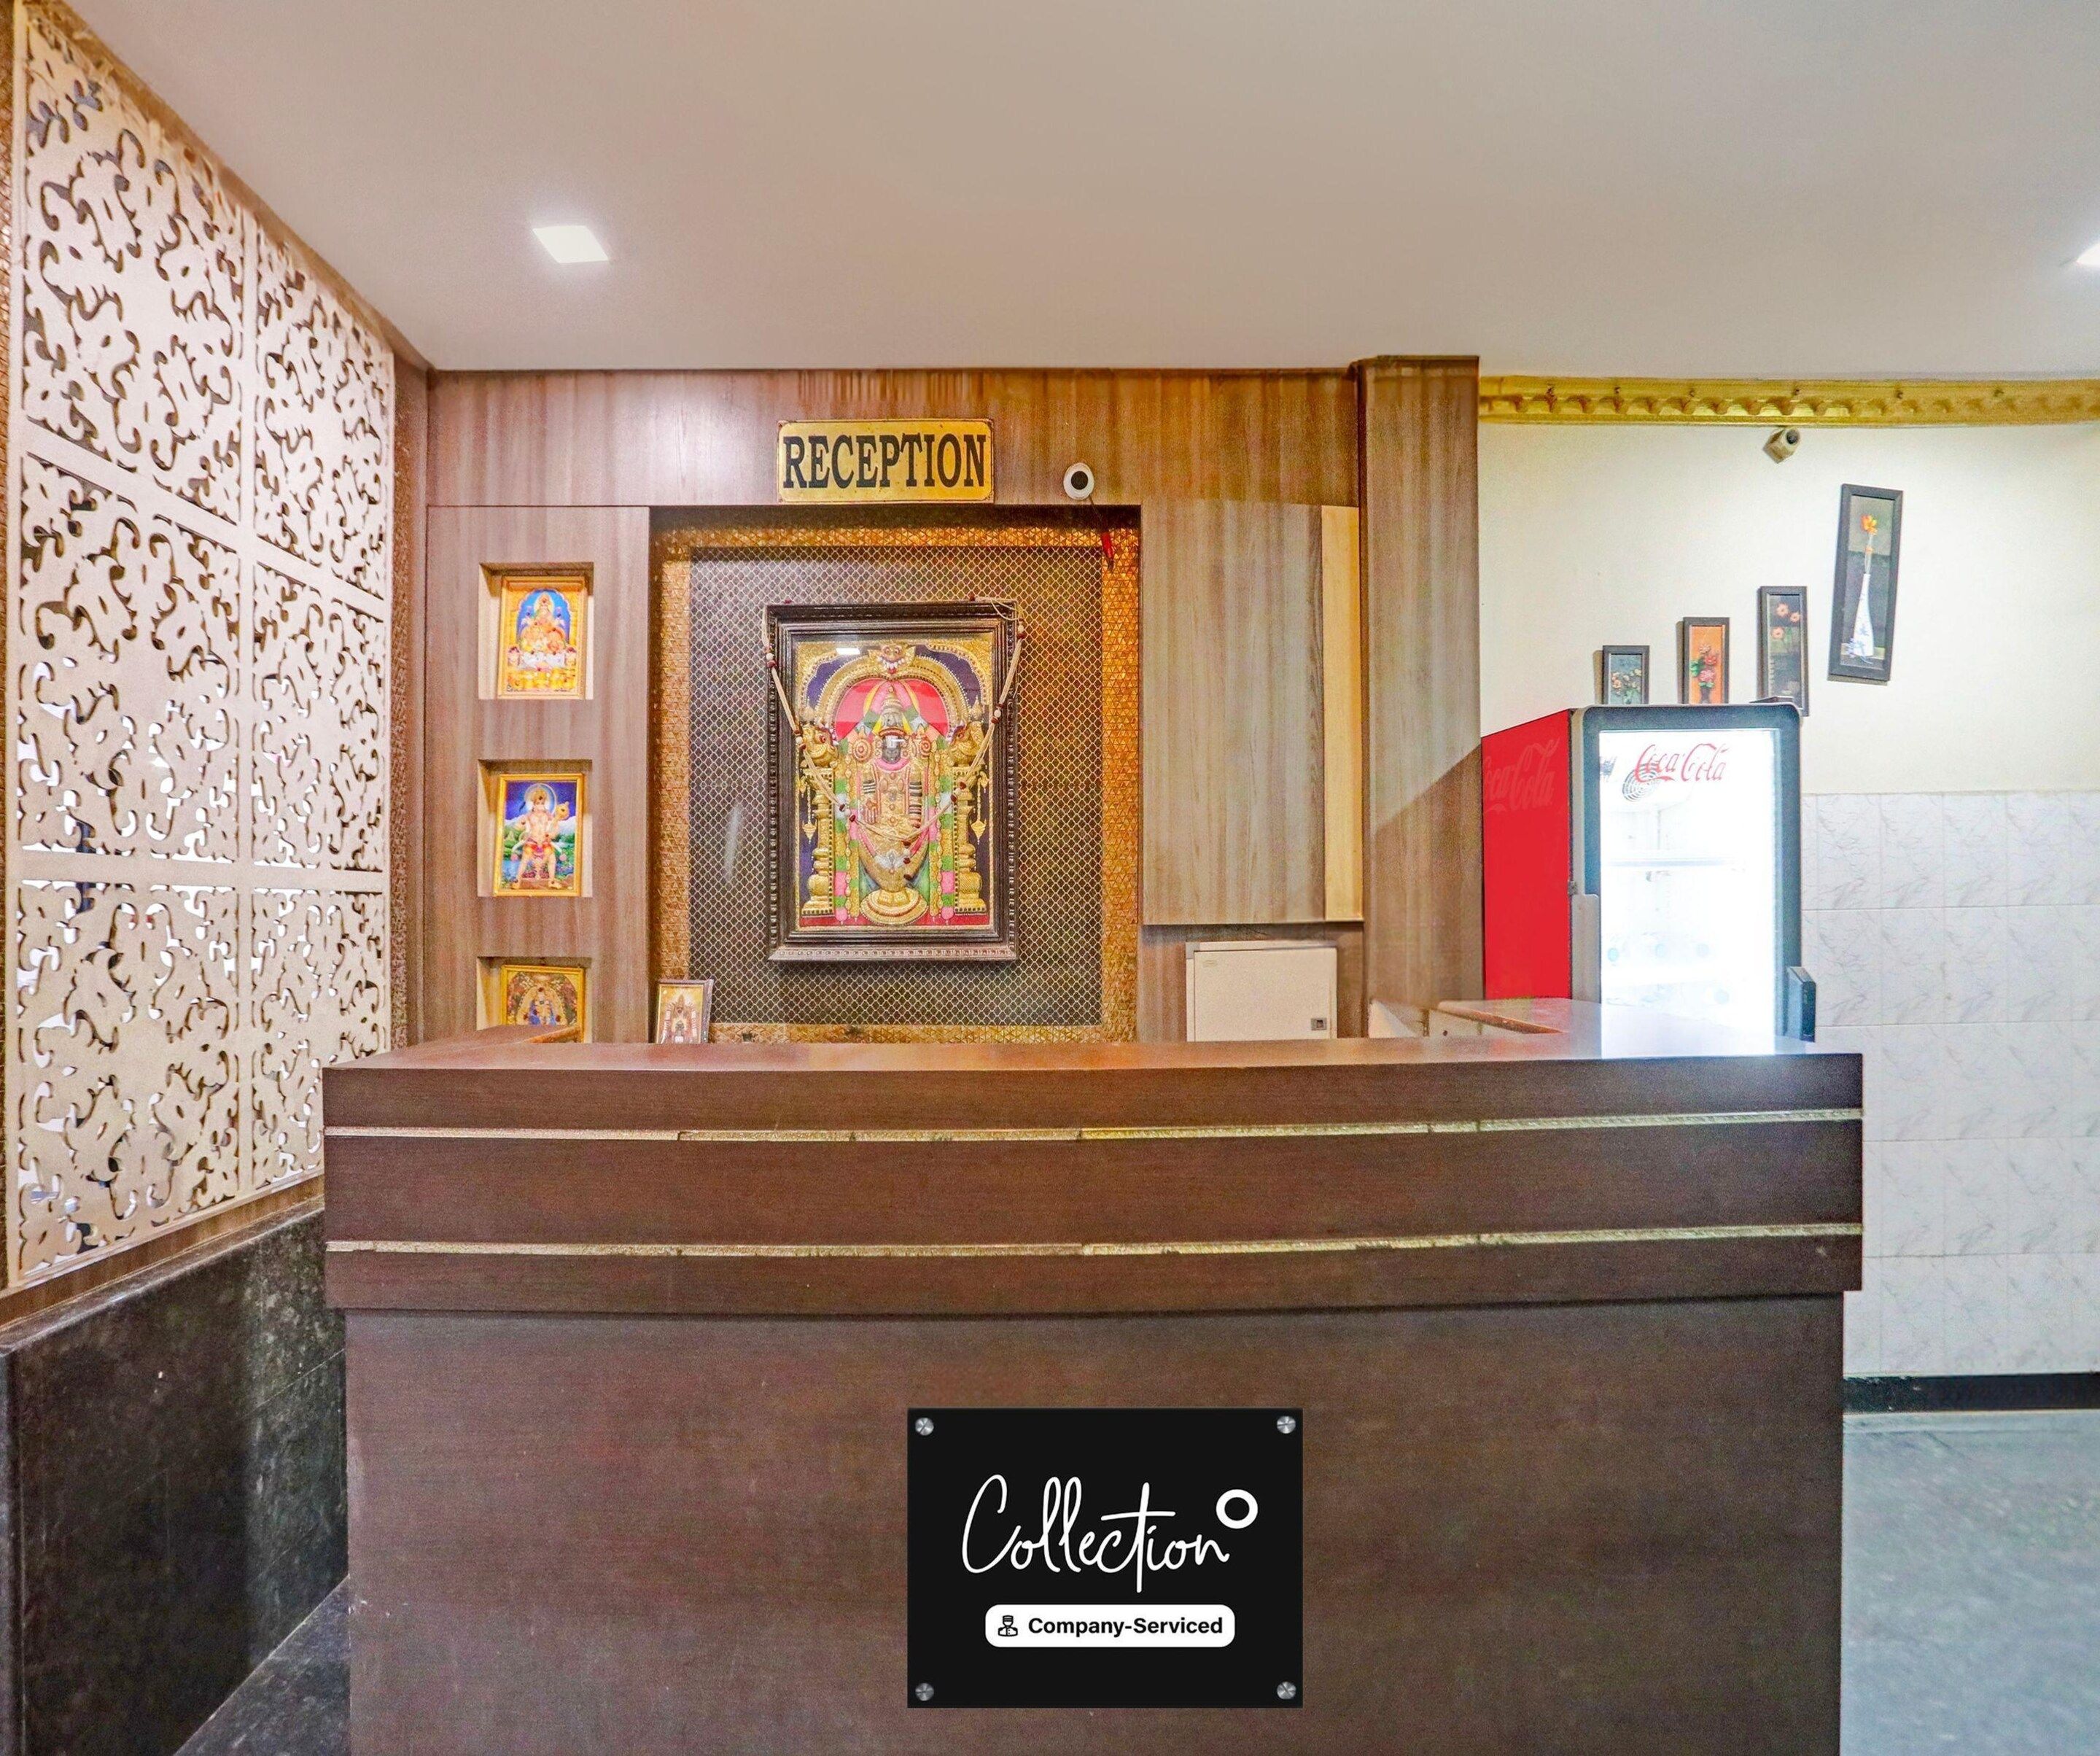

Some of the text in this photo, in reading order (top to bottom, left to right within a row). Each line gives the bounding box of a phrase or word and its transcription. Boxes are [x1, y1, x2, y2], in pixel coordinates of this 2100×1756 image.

[783, 432, 987, 489] RECEPTION
[962, 1474, 1230, 1593] Collection
[1028, 1617, 1223, 1638] Company-Serviced
